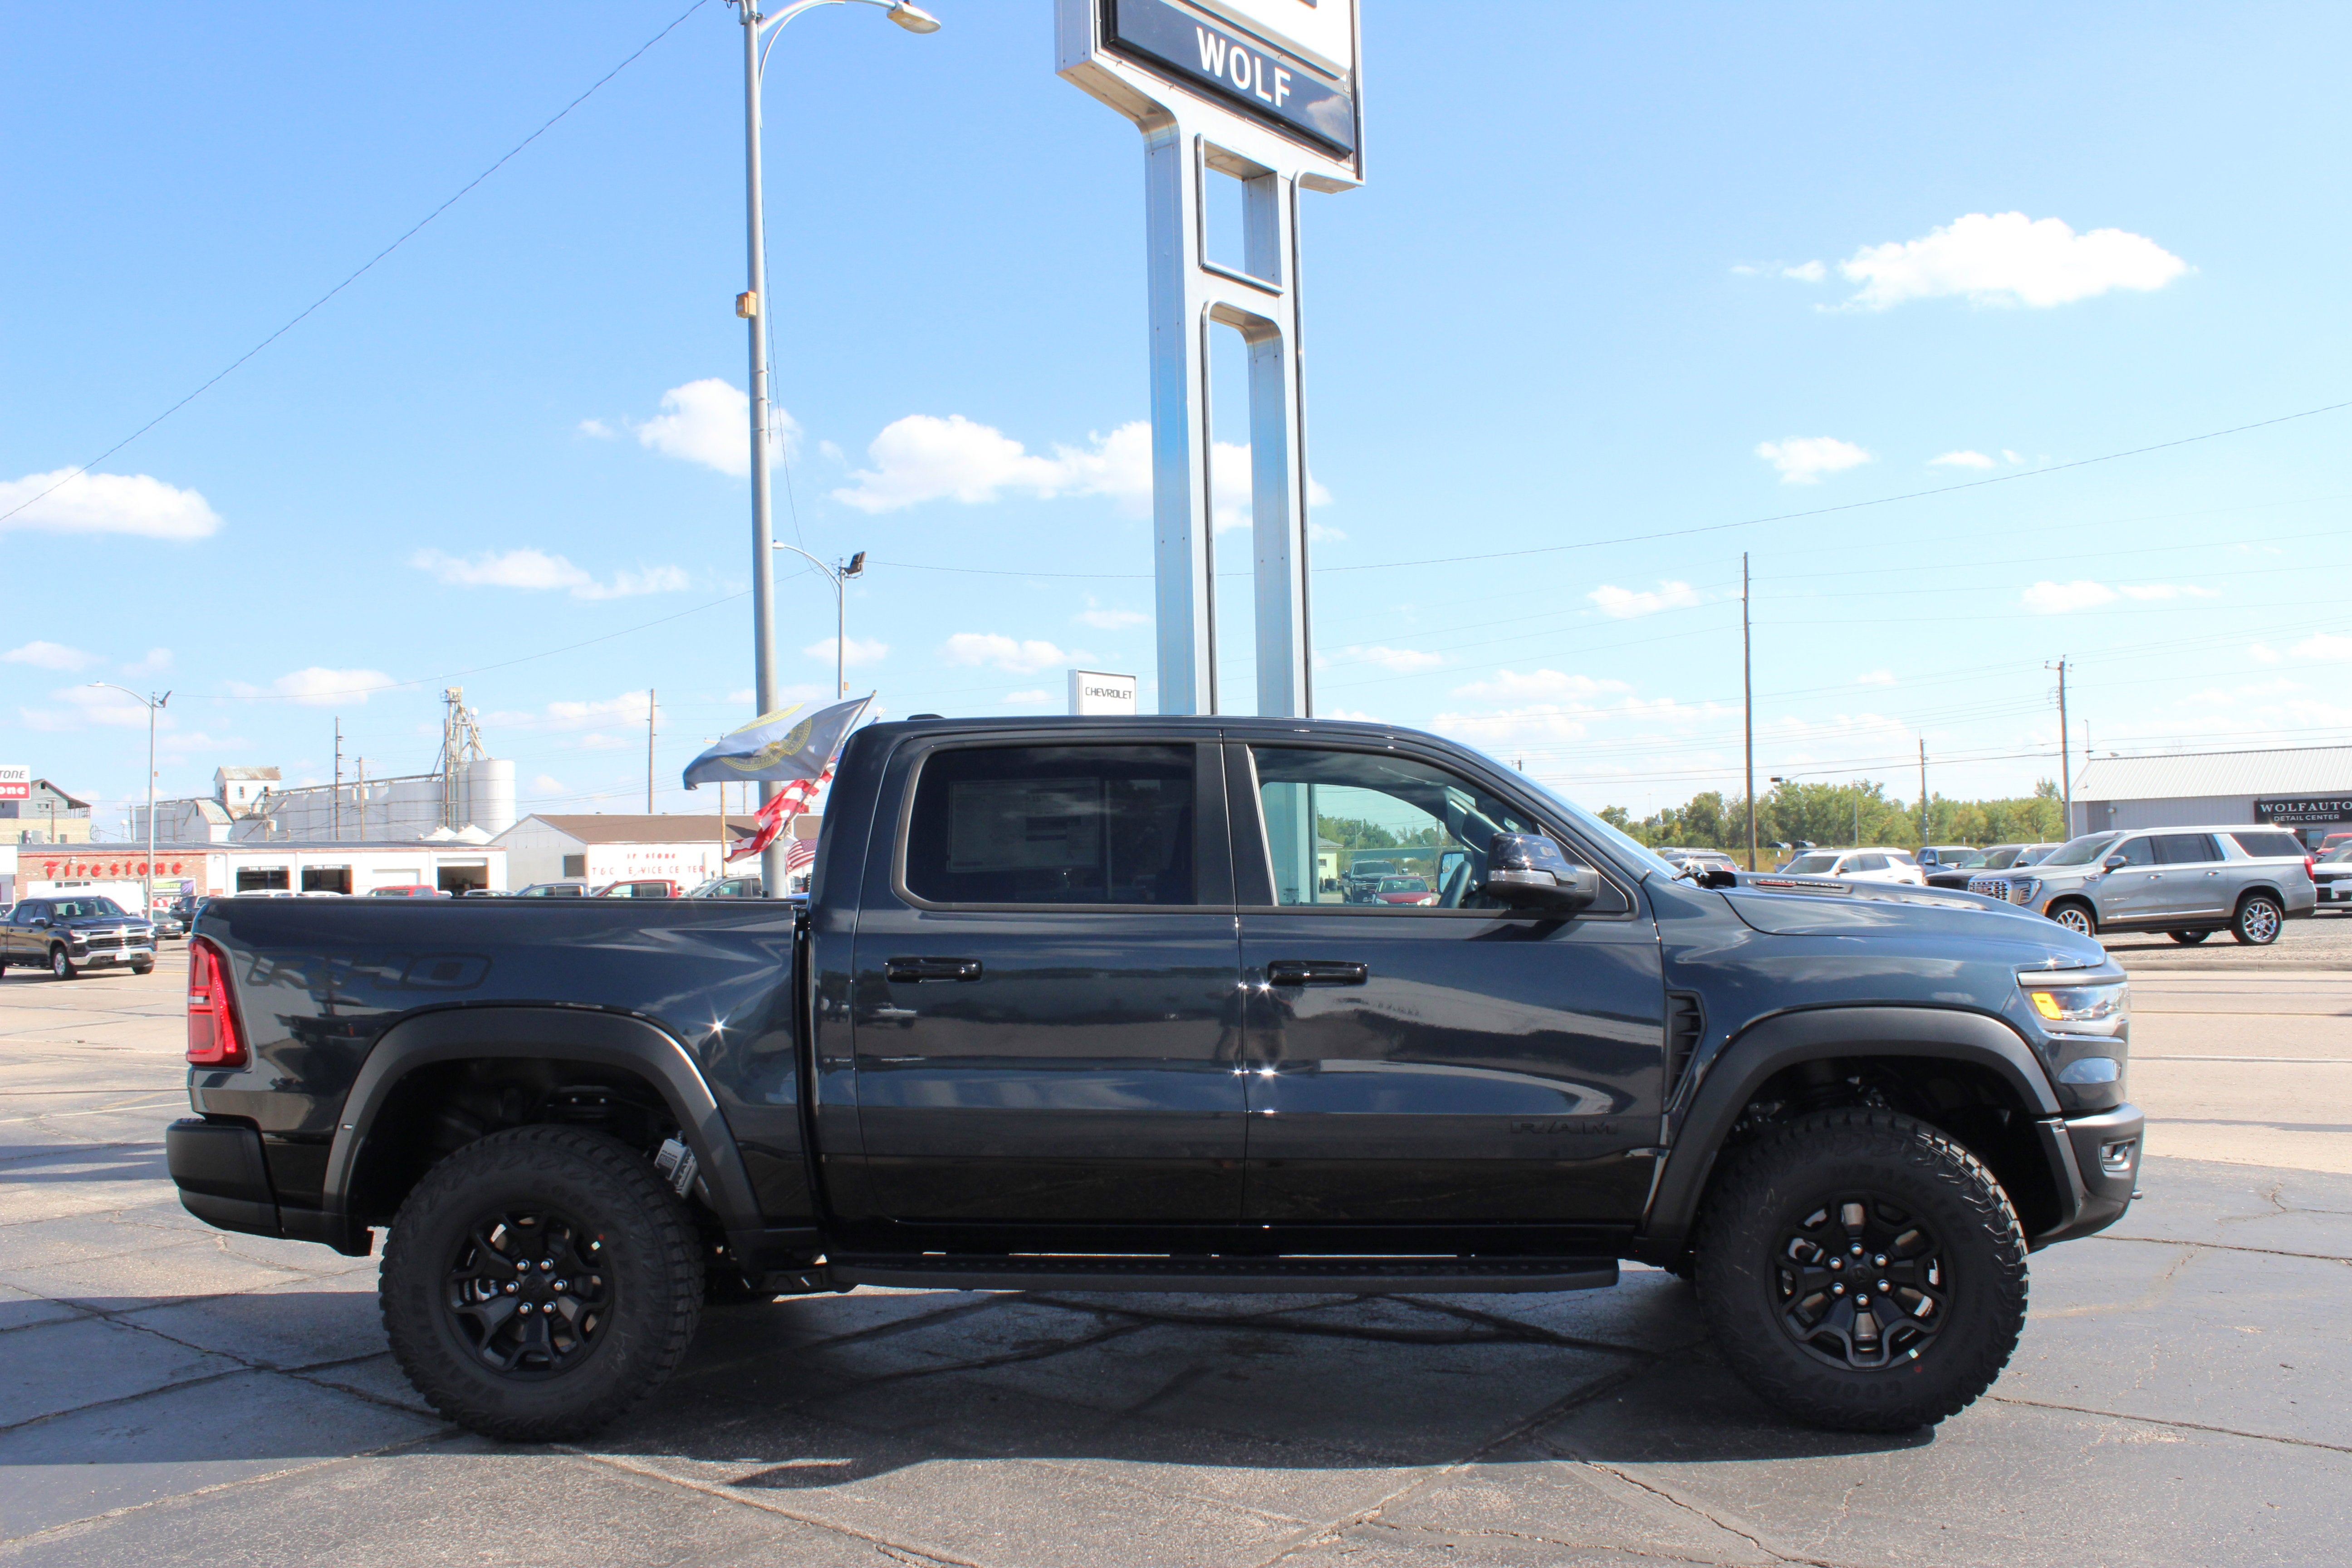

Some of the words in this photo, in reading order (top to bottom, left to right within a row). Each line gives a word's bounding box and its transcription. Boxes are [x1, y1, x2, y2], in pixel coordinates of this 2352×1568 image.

[1196, 26, 1291, 108] WOLF
[1085, 686, 1132, 699] CHEVROLET
[43, 860, 182, 879] Firestone
[1510, 1121, 1618, 1134] RAM
